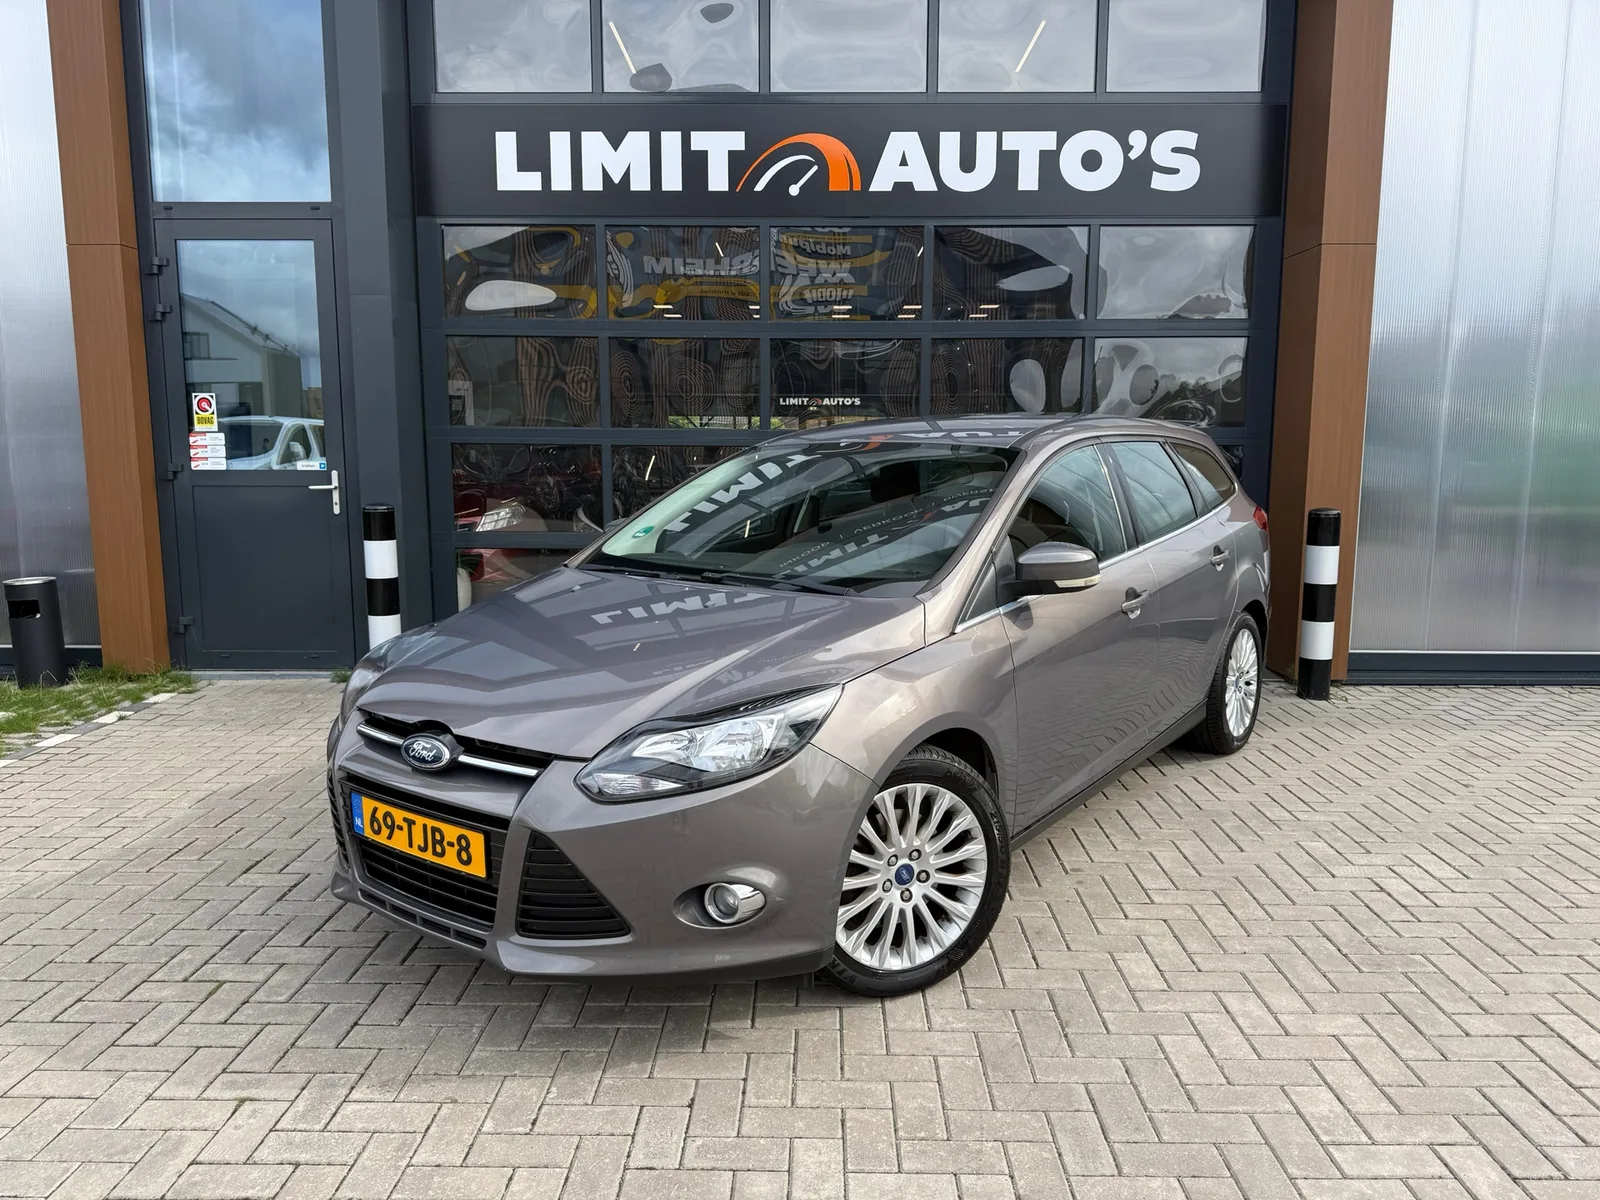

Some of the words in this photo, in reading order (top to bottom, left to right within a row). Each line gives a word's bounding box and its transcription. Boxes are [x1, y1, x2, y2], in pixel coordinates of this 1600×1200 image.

[495, 131, 745, 191] LIMIT
[868, 129, 1201, 192] AUTO'S
[780, 397, 809, 406] LIMIT
[822, 397, 861, 406] AUTO'S
[197, 416, 214, 425] BOVAG
[408, 740, 434, 762] Ford
[355, 816, 364, 828] NL
[369, 806, 472, 866] 69-TJB-8
